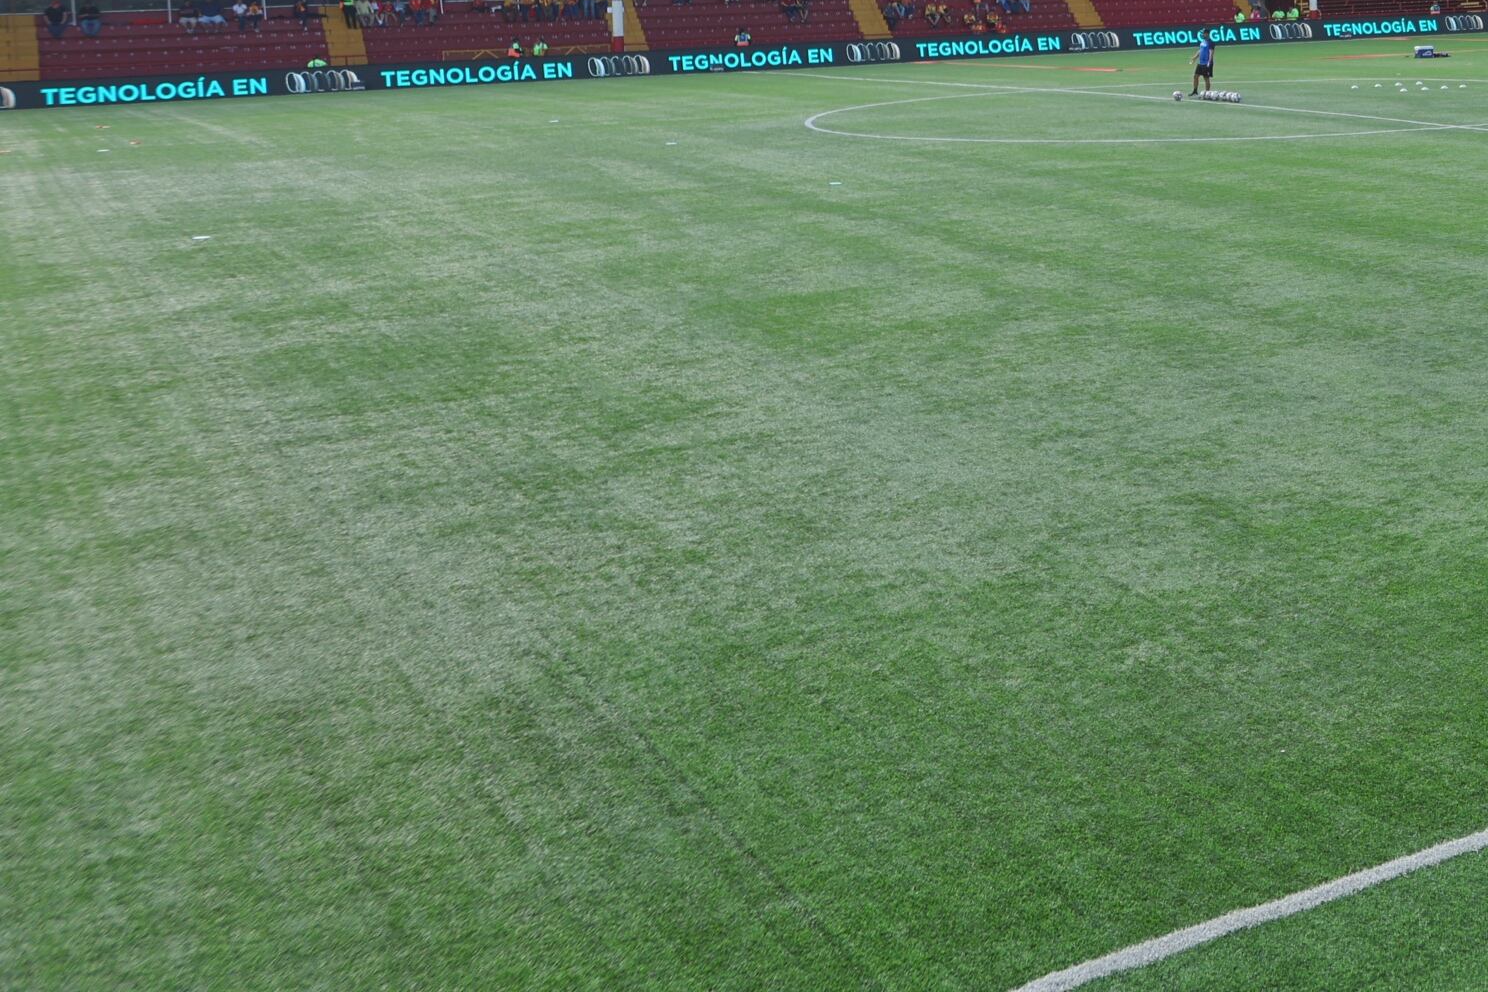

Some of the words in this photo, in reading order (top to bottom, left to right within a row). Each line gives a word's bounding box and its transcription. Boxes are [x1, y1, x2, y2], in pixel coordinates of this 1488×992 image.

[1419, 20, 1438, 32] EN
[1240, 28, 1261, 41] EN
[1037, 37, 1061, 51] EN
[807, 48, 834, 64] EN
[380, 61, 537, 88] TEGNOLOGÍA
[543, 62, 573, 79] EN
[40, 76, 226, 106] TEGNOLOGÍA
[232, 77, 268, 96] EN
